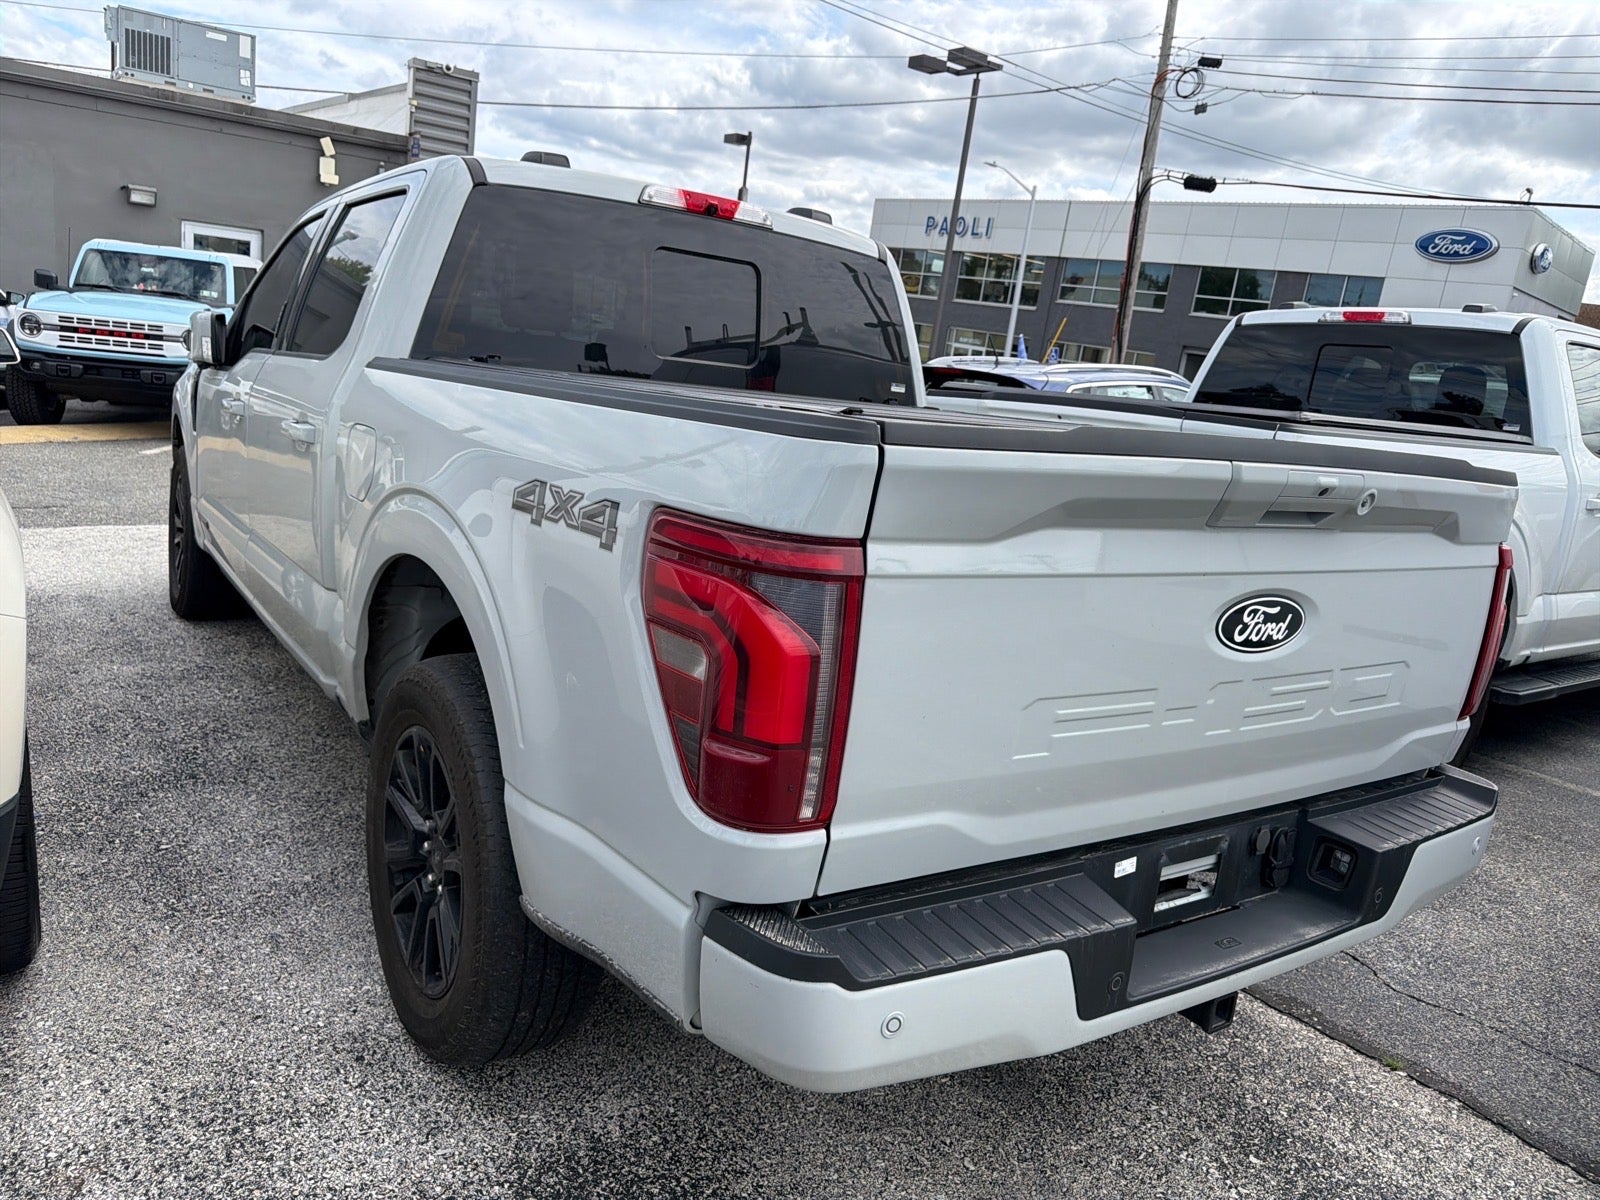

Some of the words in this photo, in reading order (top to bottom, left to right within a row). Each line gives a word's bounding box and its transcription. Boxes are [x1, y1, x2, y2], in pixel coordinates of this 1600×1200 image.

[924, 215, 993, 238] PAOLI
[1428, 234, 1477, 255] Ford
[1233, 605, 1293, 643] Ford
